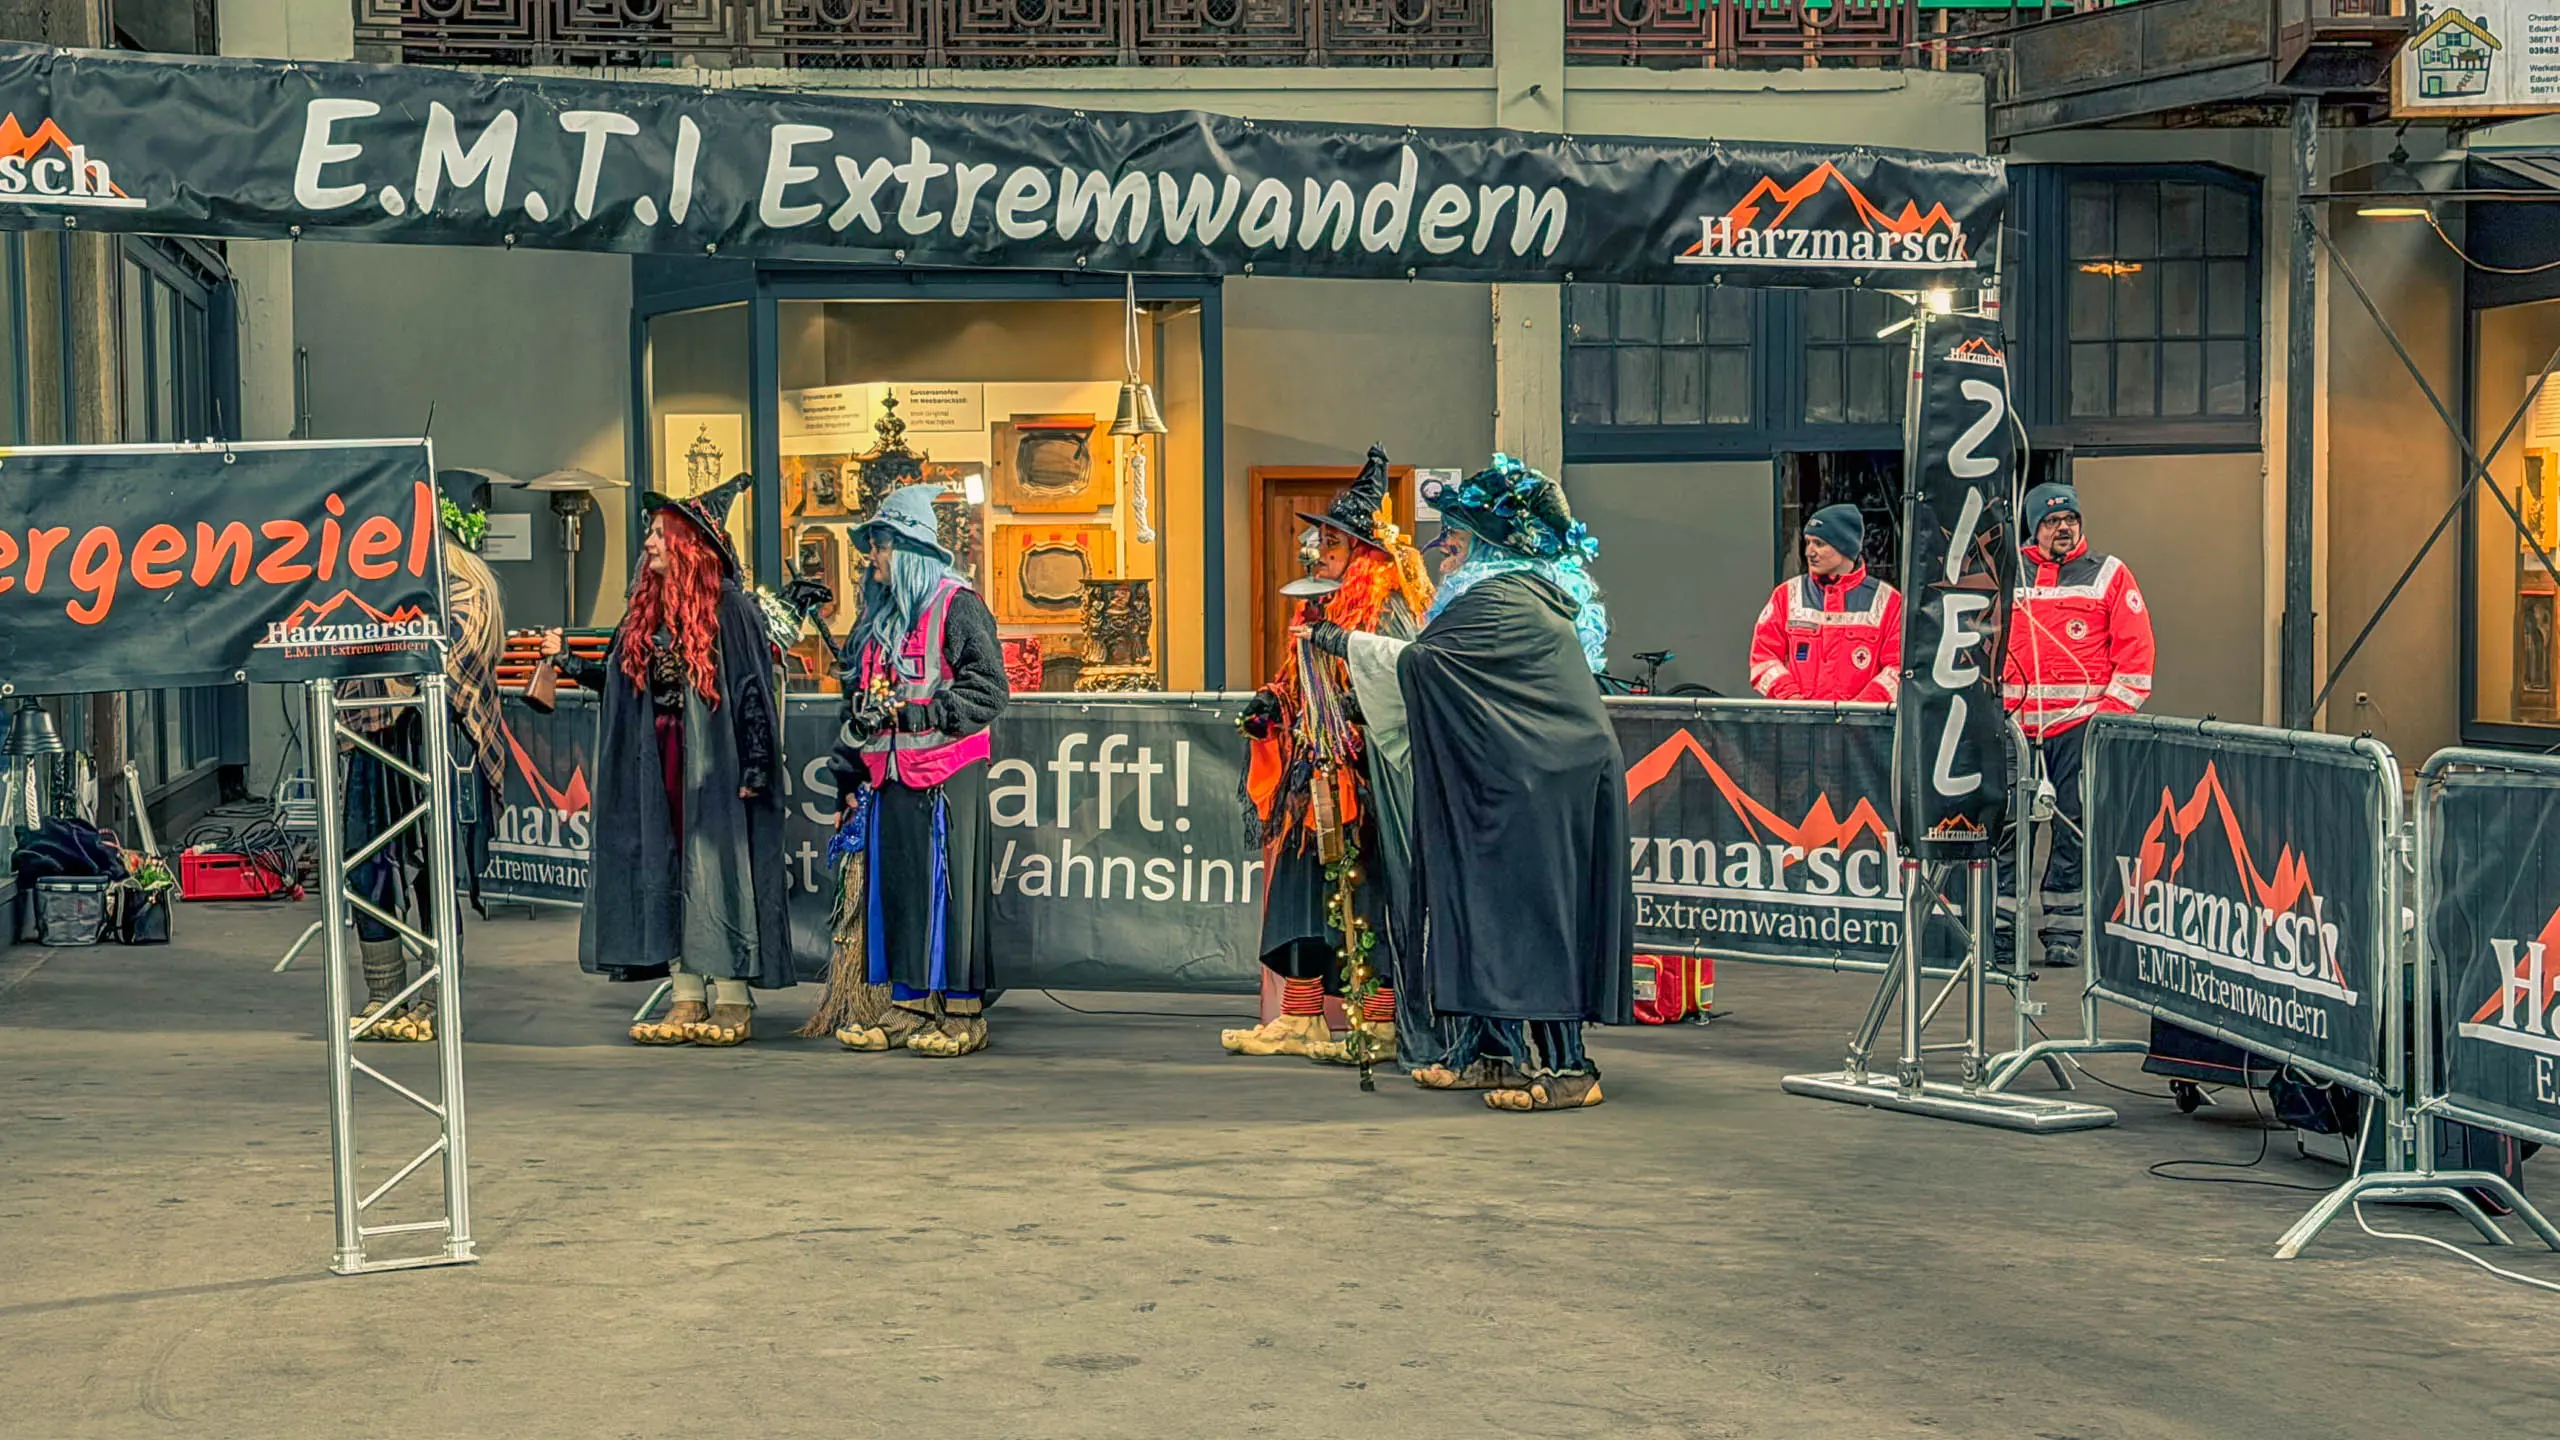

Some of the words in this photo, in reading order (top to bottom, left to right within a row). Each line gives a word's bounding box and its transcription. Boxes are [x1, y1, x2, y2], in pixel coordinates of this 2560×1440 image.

[759, 123, 1568, 257] Extremwandern
[1699, 214, 1967, 263] Harzmarsch
[267, 614, 439, 645] Harzmarsch
[330, 641, 429, 657] Extremwandern
[1634, 894, 1900, 946] Extremwandern
[2116, 855, 2340, 984] Harzmarsch
[2189, 959, 2329, 1040] Extremwandern
[2490, 938, 2560, 1040] H
